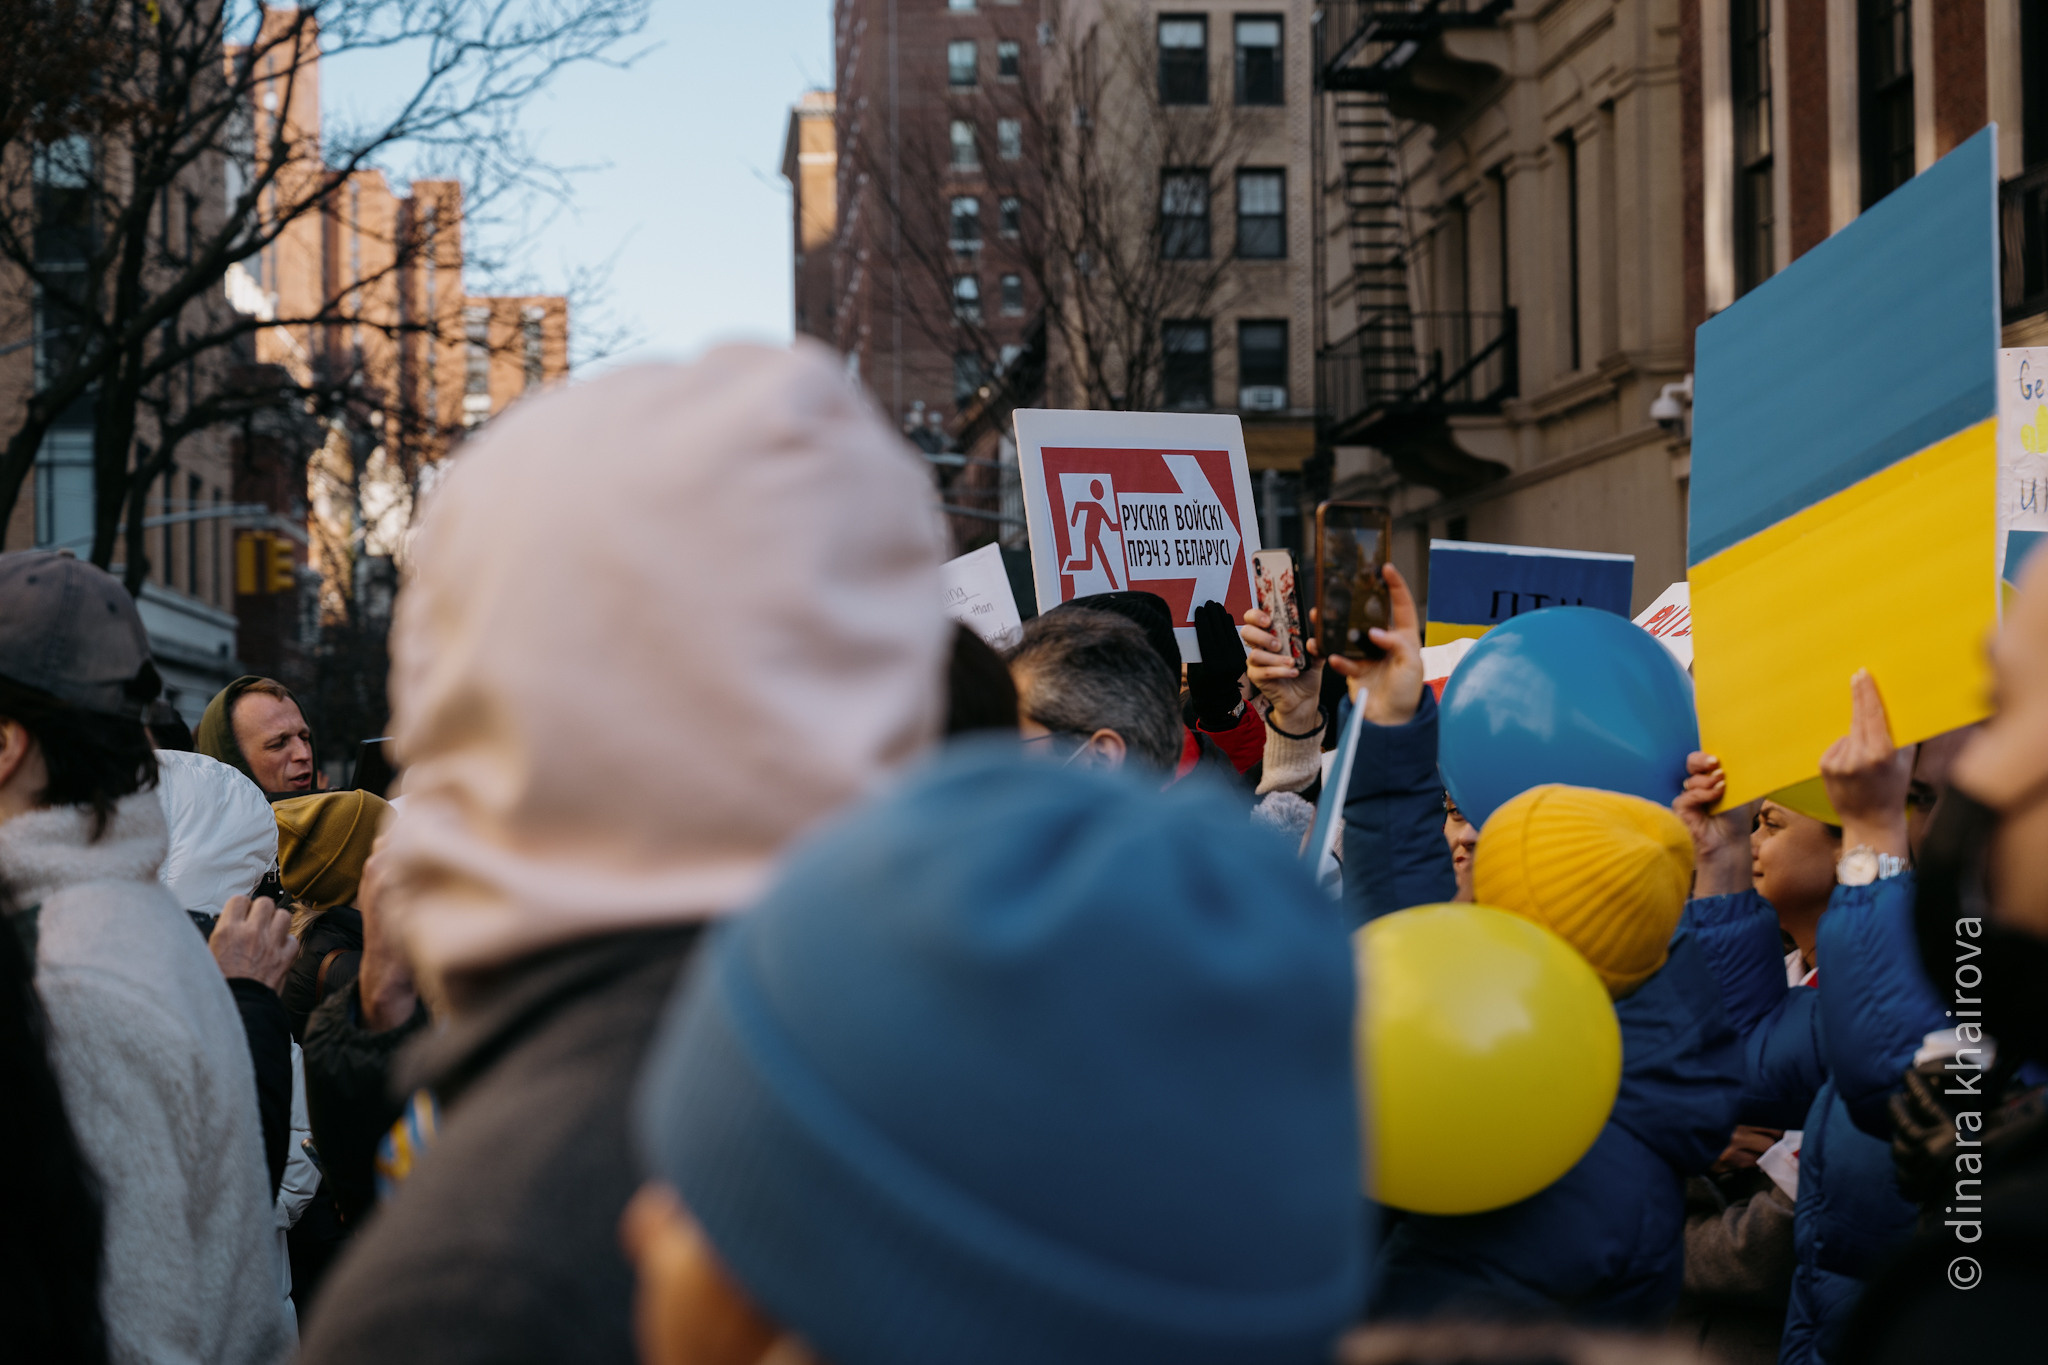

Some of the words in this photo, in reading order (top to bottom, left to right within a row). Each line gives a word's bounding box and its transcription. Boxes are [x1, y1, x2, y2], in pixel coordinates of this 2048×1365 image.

[2021, 477, 2048, 514] U
[1121, 504, 1170, 531] РУСКІЯ
[1174, 498, 1224, 531] ВОЙСКІ
[1127, 539, 1161, 567] ПРЭЧ
[1174, 539, 1232, 567] БЕЛАРУСІ
